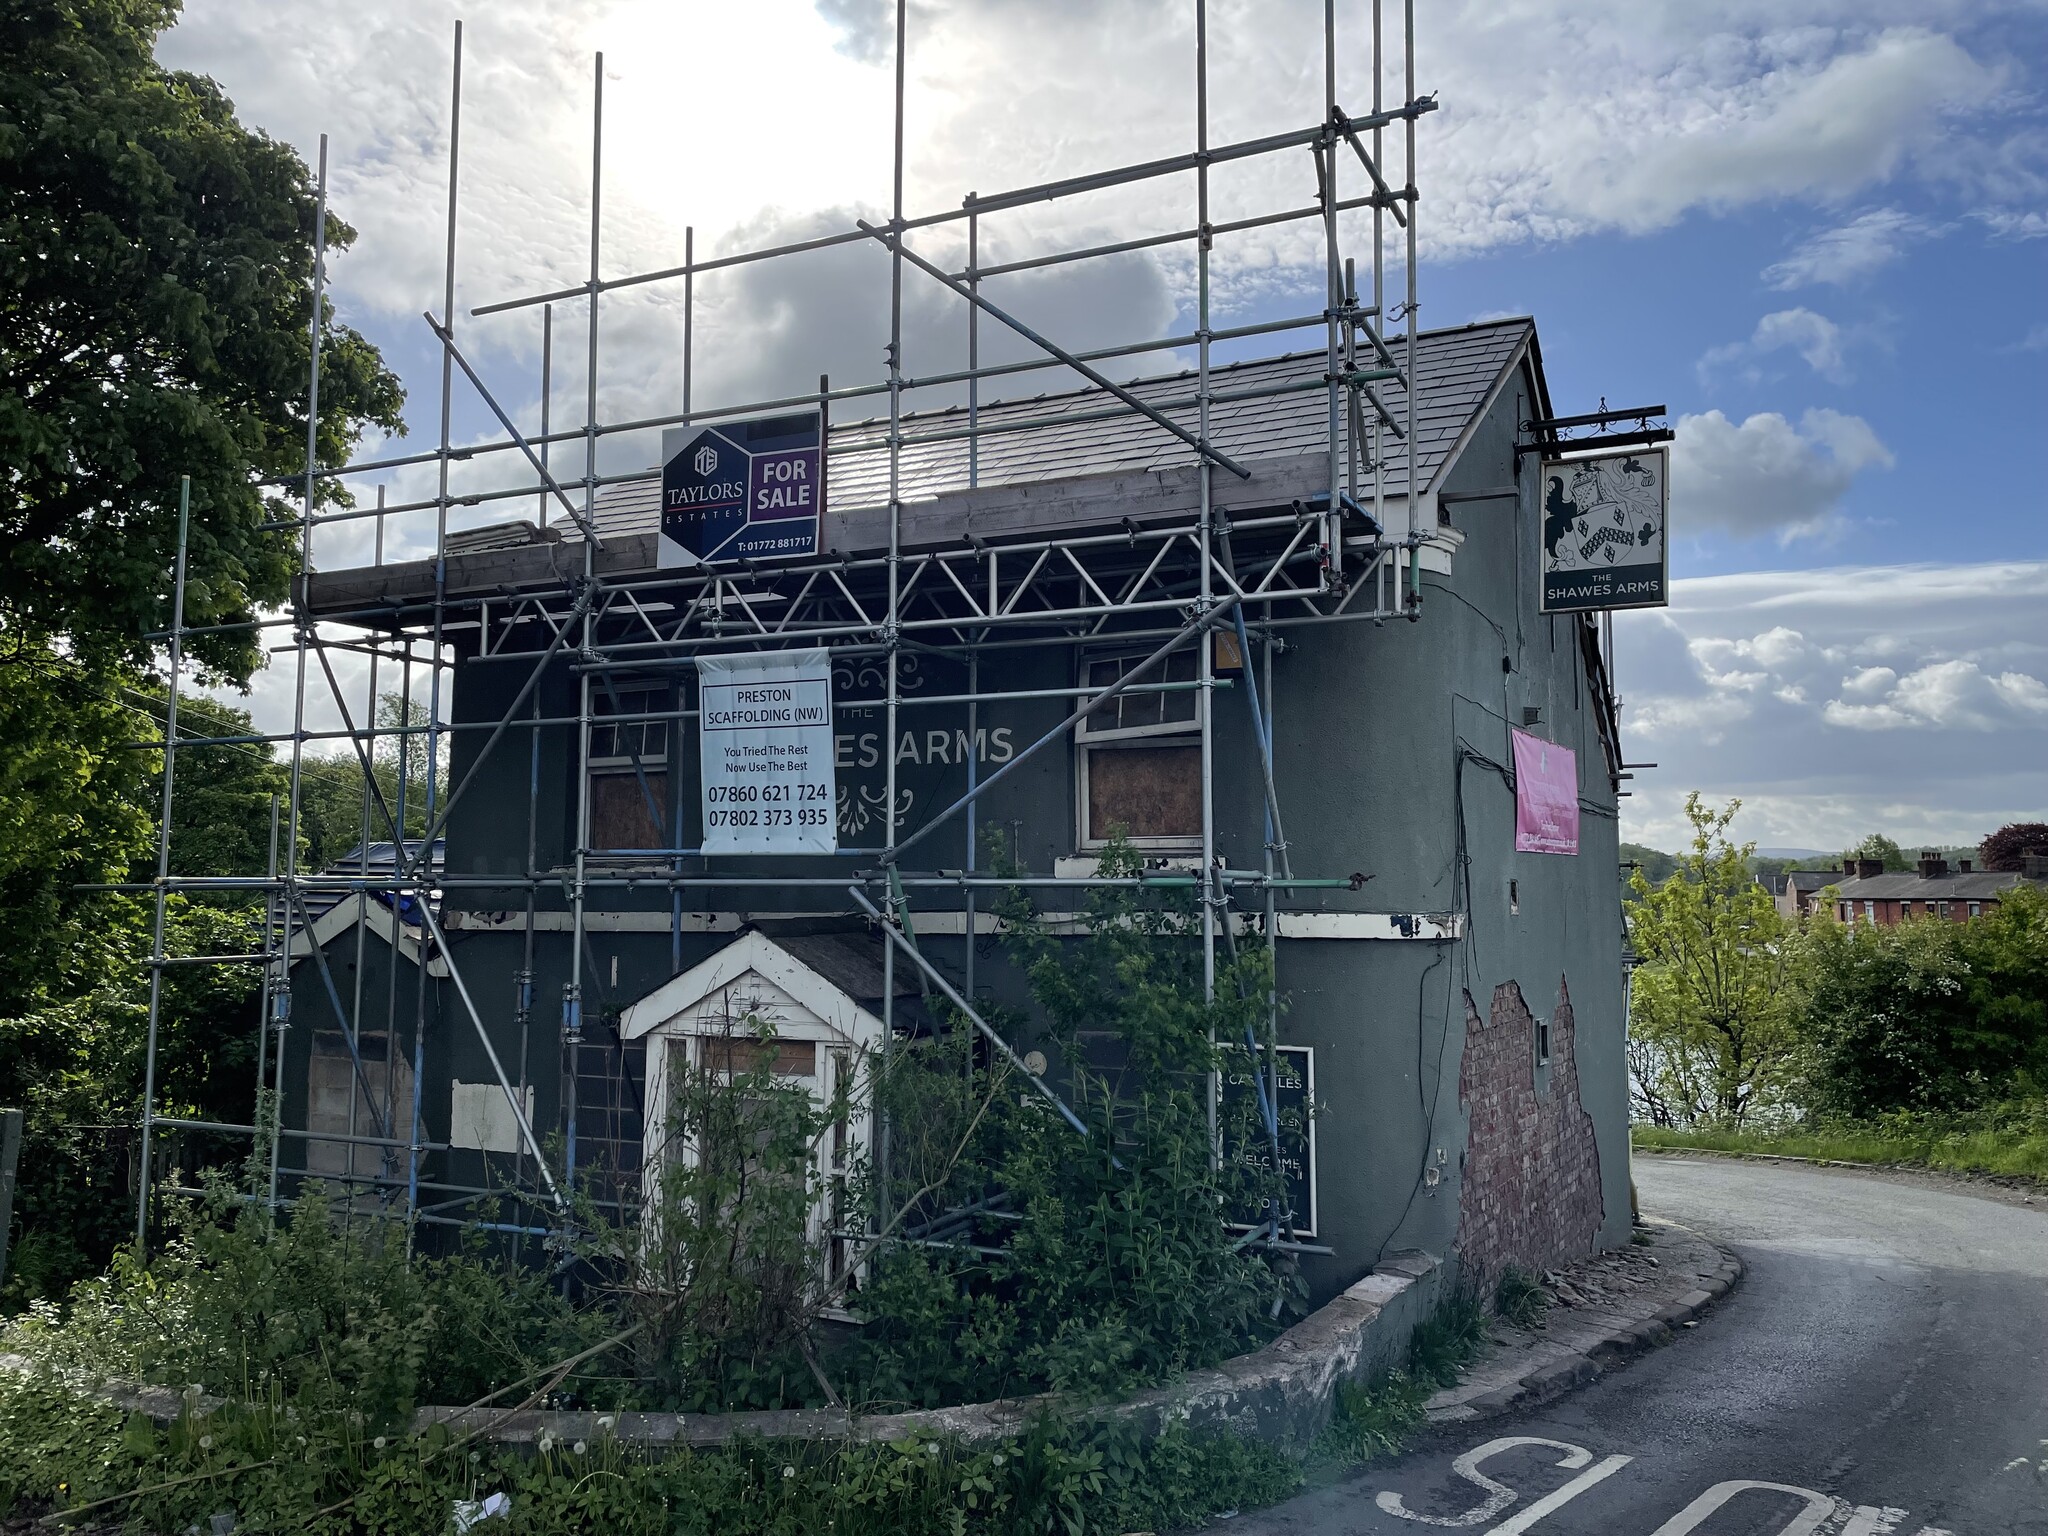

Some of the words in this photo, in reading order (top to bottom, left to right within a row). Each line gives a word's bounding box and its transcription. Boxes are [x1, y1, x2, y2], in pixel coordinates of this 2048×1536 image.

[763, 459, 807, 484] FOR
[668, 482, 743, 505] TAYLORS
[757, 484, 810, 510] SALE
[666, 508, 743, 524] ESTATES
[738, 542, 746, 551] T:
[747, 540, 776, 551] 01772
[777, 536, 812, 548] 881717
[1592, 573, 1612, 582] THE
[1547, 584, 1612, 599] SHAWES
[1616, 580, 1659, 594] ARMS
[737, 689, 791, 703] PRESTON
[708, 709, 791, 724] SCAFFOLDING
[794, 707, 823, 722] (NW)
[724, 747, 741, 757] You
[743, 745, 767, 756] Tried
[768, 745, 786, 755] The
[788, 744, 808, 755] Rest
[895, 727, 1013, 766] ARMS
[725, 763, 746, 772] Now
[748, 762, 767, 772] Use
[768, 761, 785, 771] The
[787, 760, 808, 771] Best
[708, 785, 758, 802] 07860
[762, 785, 790, 801] 621
[797, 784, 827, 800] 724
[709, 810, 758, 826] 07802
[763, 809, 792, 826] 373
[798, 808, 827, 825] 935
